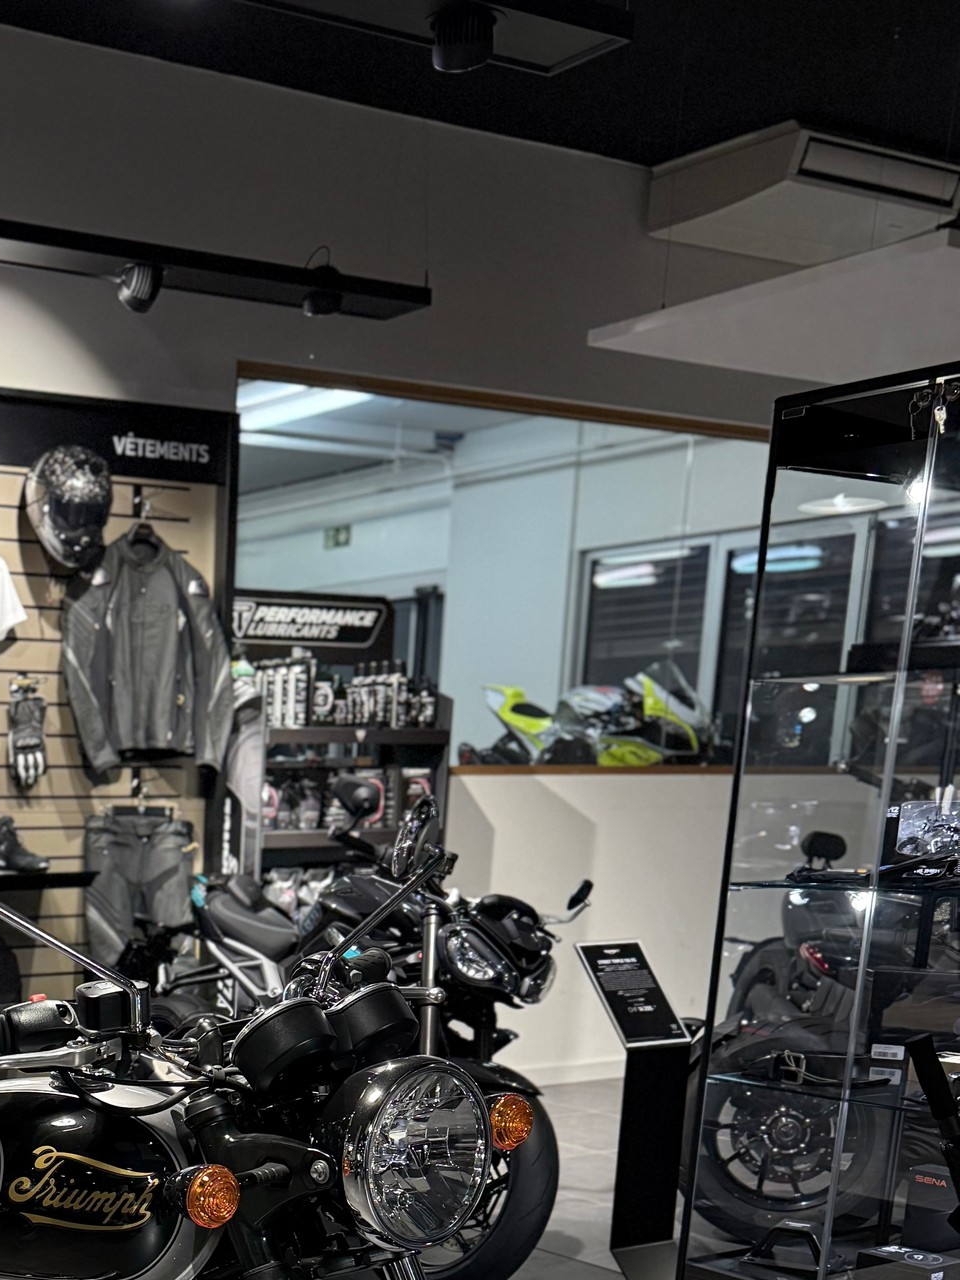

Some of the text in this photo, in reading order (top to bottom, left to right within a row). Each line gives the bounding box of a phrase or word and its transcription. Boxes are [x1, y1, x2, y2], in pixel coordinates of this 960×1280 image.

[112, 431, 210, 464] VÊTEMENTS
[253, 604, 379, 627] PERFORMANCE
[246, 621, 340, 639] LUBRICANTS
[8, 1145, 159, 1230] Triumph
[915, 1174, 947, 1188] SENA
